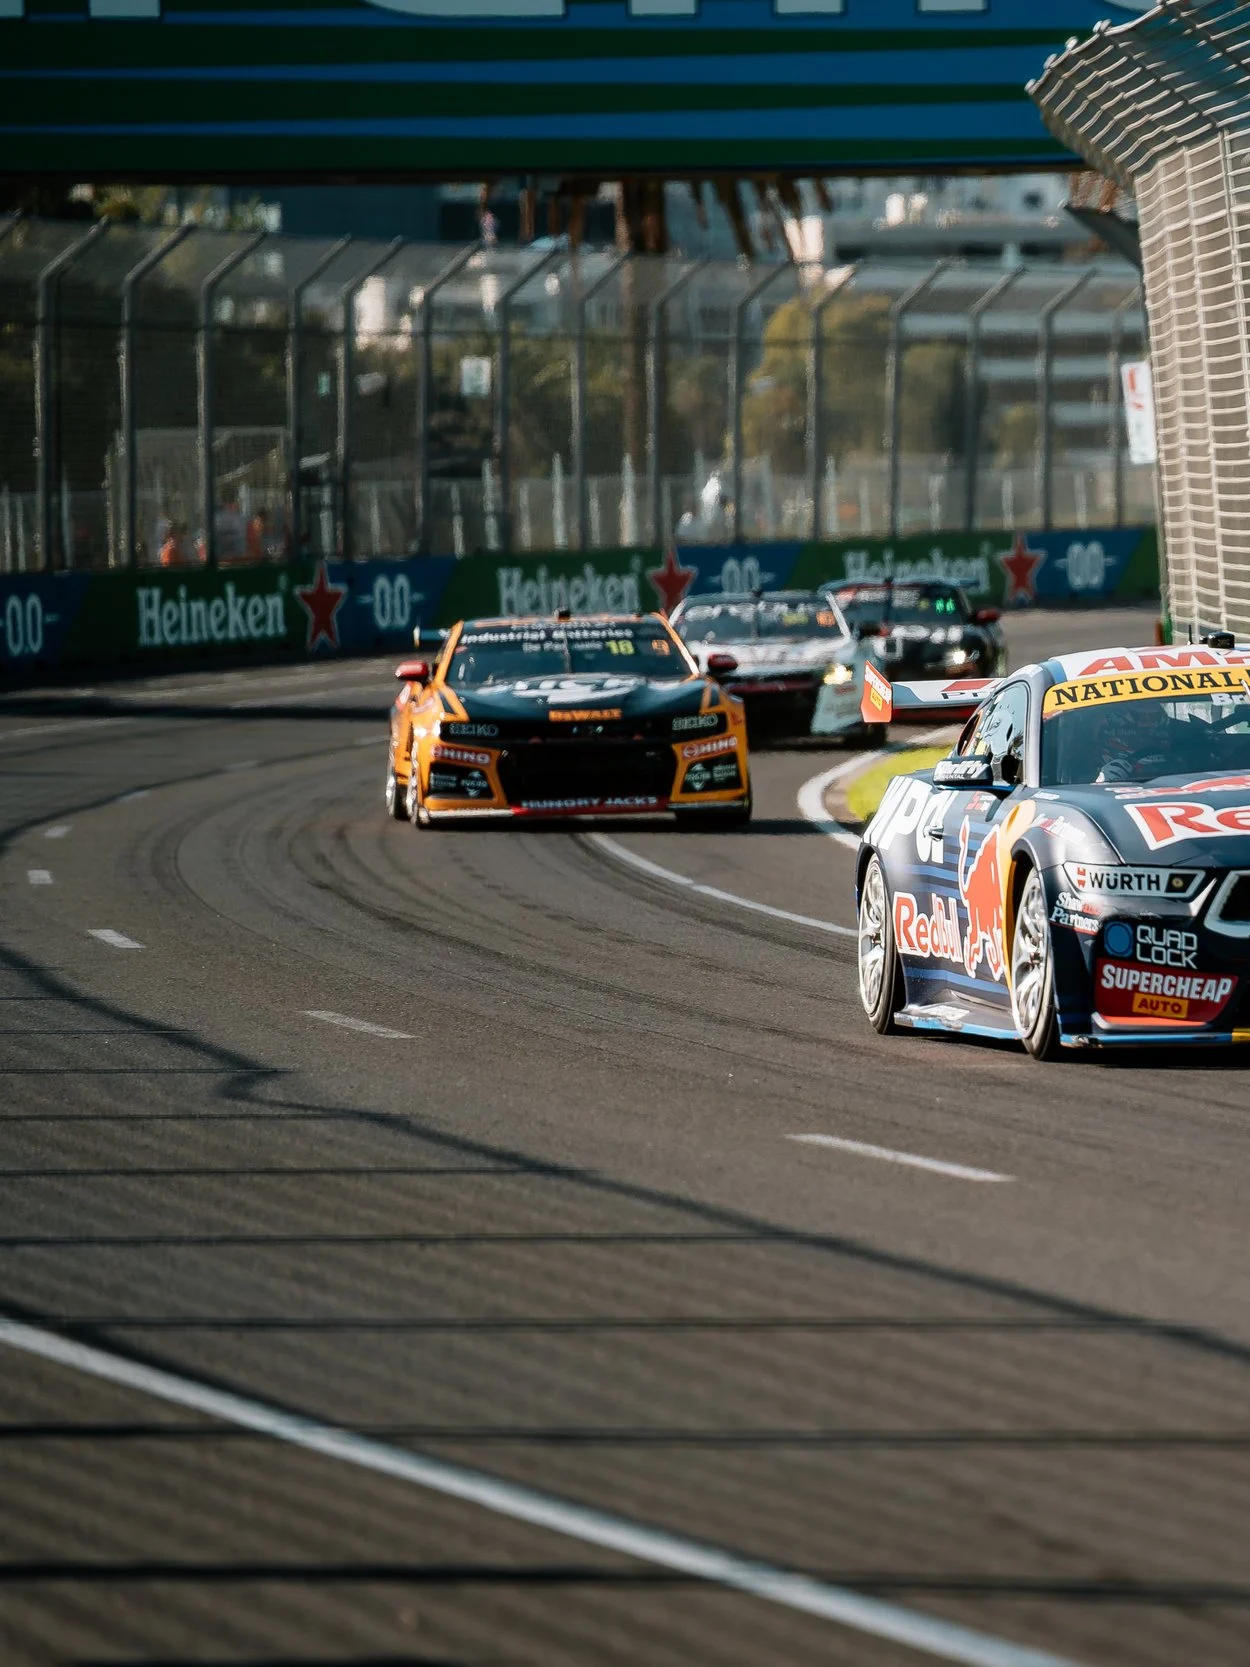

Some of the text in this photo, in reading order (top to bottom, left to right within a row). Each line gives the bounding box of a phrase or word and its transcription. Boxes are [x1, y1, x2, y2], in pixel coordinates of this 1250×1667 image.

[136, 581, 287, 646] Heineken
[1053, 671, 1246, 706] NATIONAL
[450, 723, 499, 738] SEIKO
[671, 714, 719, 731] SEIKO
[443, 748, 491, 765] HINO
[1089, 871, 1161, 891] WÜRTH
[893, 891, 940, 958] Red
[1049, 906, 1100, 932] Partners
[1136, 924, 1198, 951] QUAD
[1136, 941, 1198, 969] LOCK
[1100, 963, 1233, 1003] SUPERCHEAP
[1137, 997, 1183, 1014] AUTO
